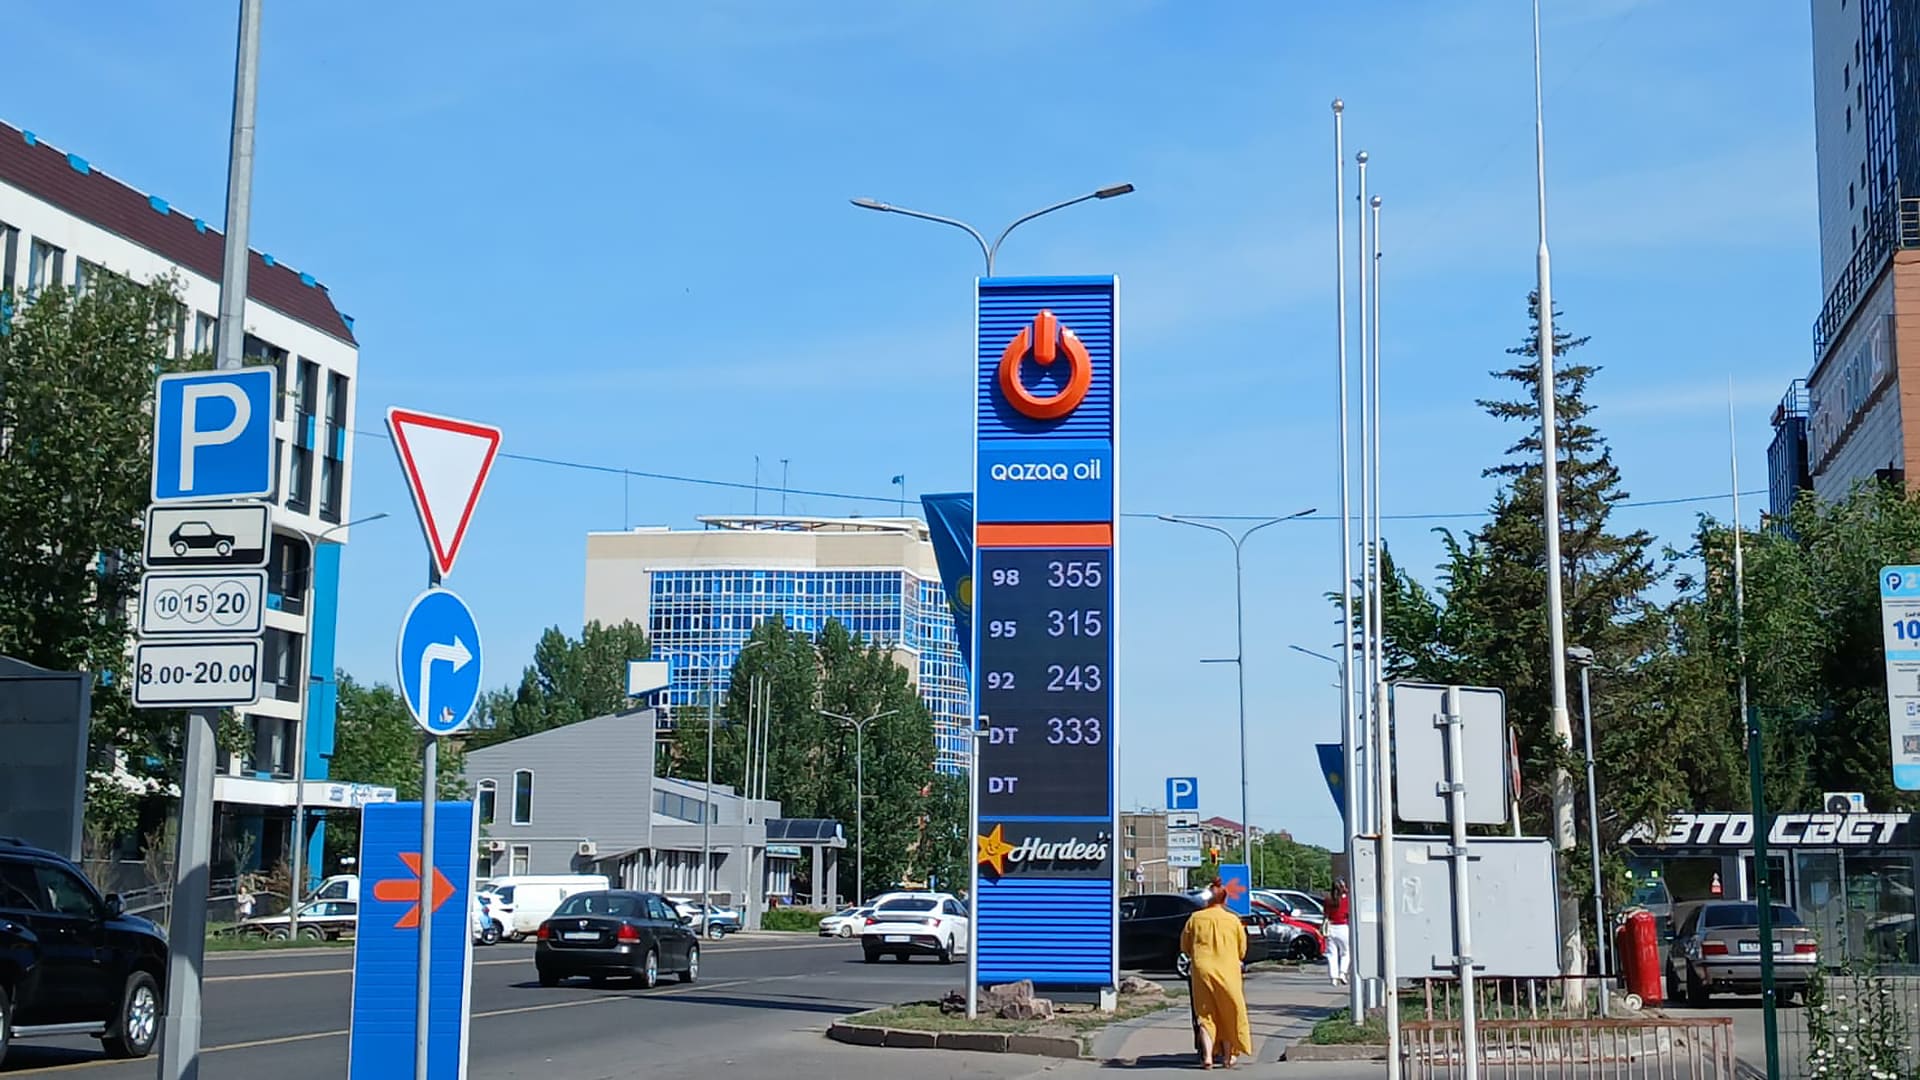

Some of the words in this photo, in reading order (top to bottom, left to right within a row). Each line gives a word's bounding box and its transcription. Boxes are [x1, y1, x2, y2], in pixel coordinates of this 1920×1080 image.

[179, 382, 251, 491] P
[1073, 458, 1101, 480] oil
[992, 569, 1020, 586] 98
[1047, 561, 1102, 587] 355
[158, 596, 178, 612] 10
[184, 594, 208, 613] 15
[215, 592, 245, 614] 20
[989, 620, 1017, 638] 95
[1047, 609, 1102, 636] 315
[140, 661, 254, 685] 8.00-20.00
[987, 671, 1015, 689] 92
[1047, 664, 1102, 691] 243
[989, 727, 1019, 744] DT
[1047, 717, 1101, 745] 333
[988, 776, 1019, 794] DT
[1171, 779, 1192, 809] P
[1768, 813, 1911, 844] СВЕТ
[1007, 832, 1109, 863] Hardee's
